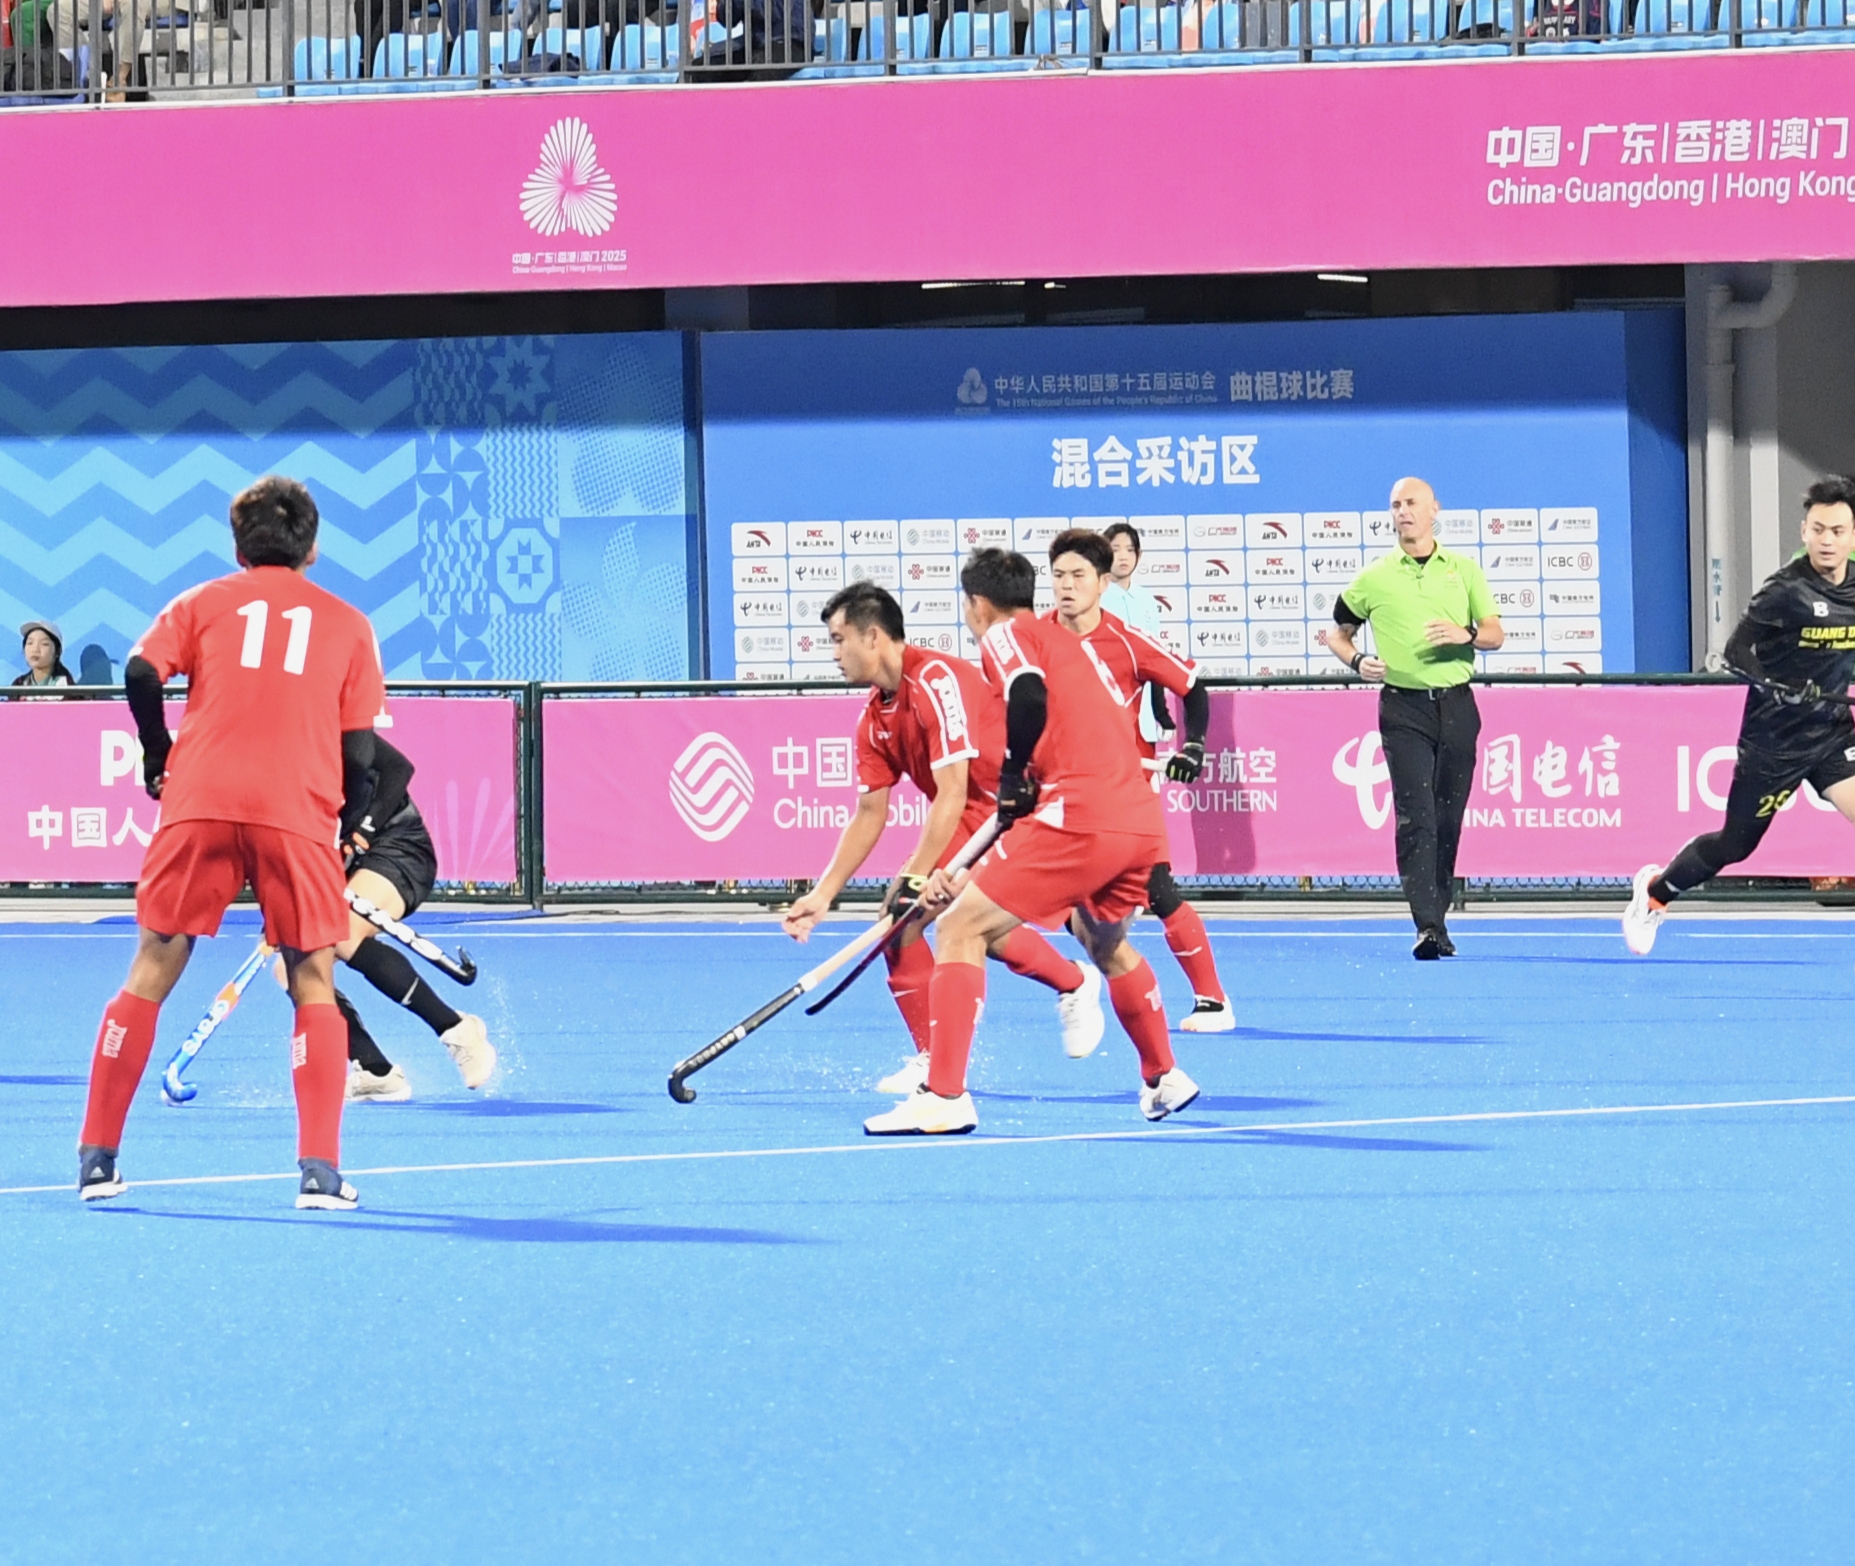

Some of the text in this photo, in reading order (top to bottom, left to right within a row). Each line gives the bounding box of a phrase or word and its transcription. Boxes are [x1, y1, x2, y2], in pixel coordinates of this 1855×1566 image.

[1725, 170, 1791, 205] Hong
[601, 249, 627, 263] 2025
[994, 368, 1355, 403] 中华人民共和国第十五届运动会 曲棍球比赛
[1051, 435, 1261, 488] 混合采访区
[1548, 556, 1574, 567] ICBC
[1493, 593, 1516, 604] CBC
[238, 599, 313, 676] 11
[1801, 627, 1846, 640] GUANG
[1481, 734, 1621, 804] 国电信
[774, 798, 846, 829] China
[1168, 789, 1277, 814] SOUTHERN
[1463, 808, 1621, 828] INA TELECOM
